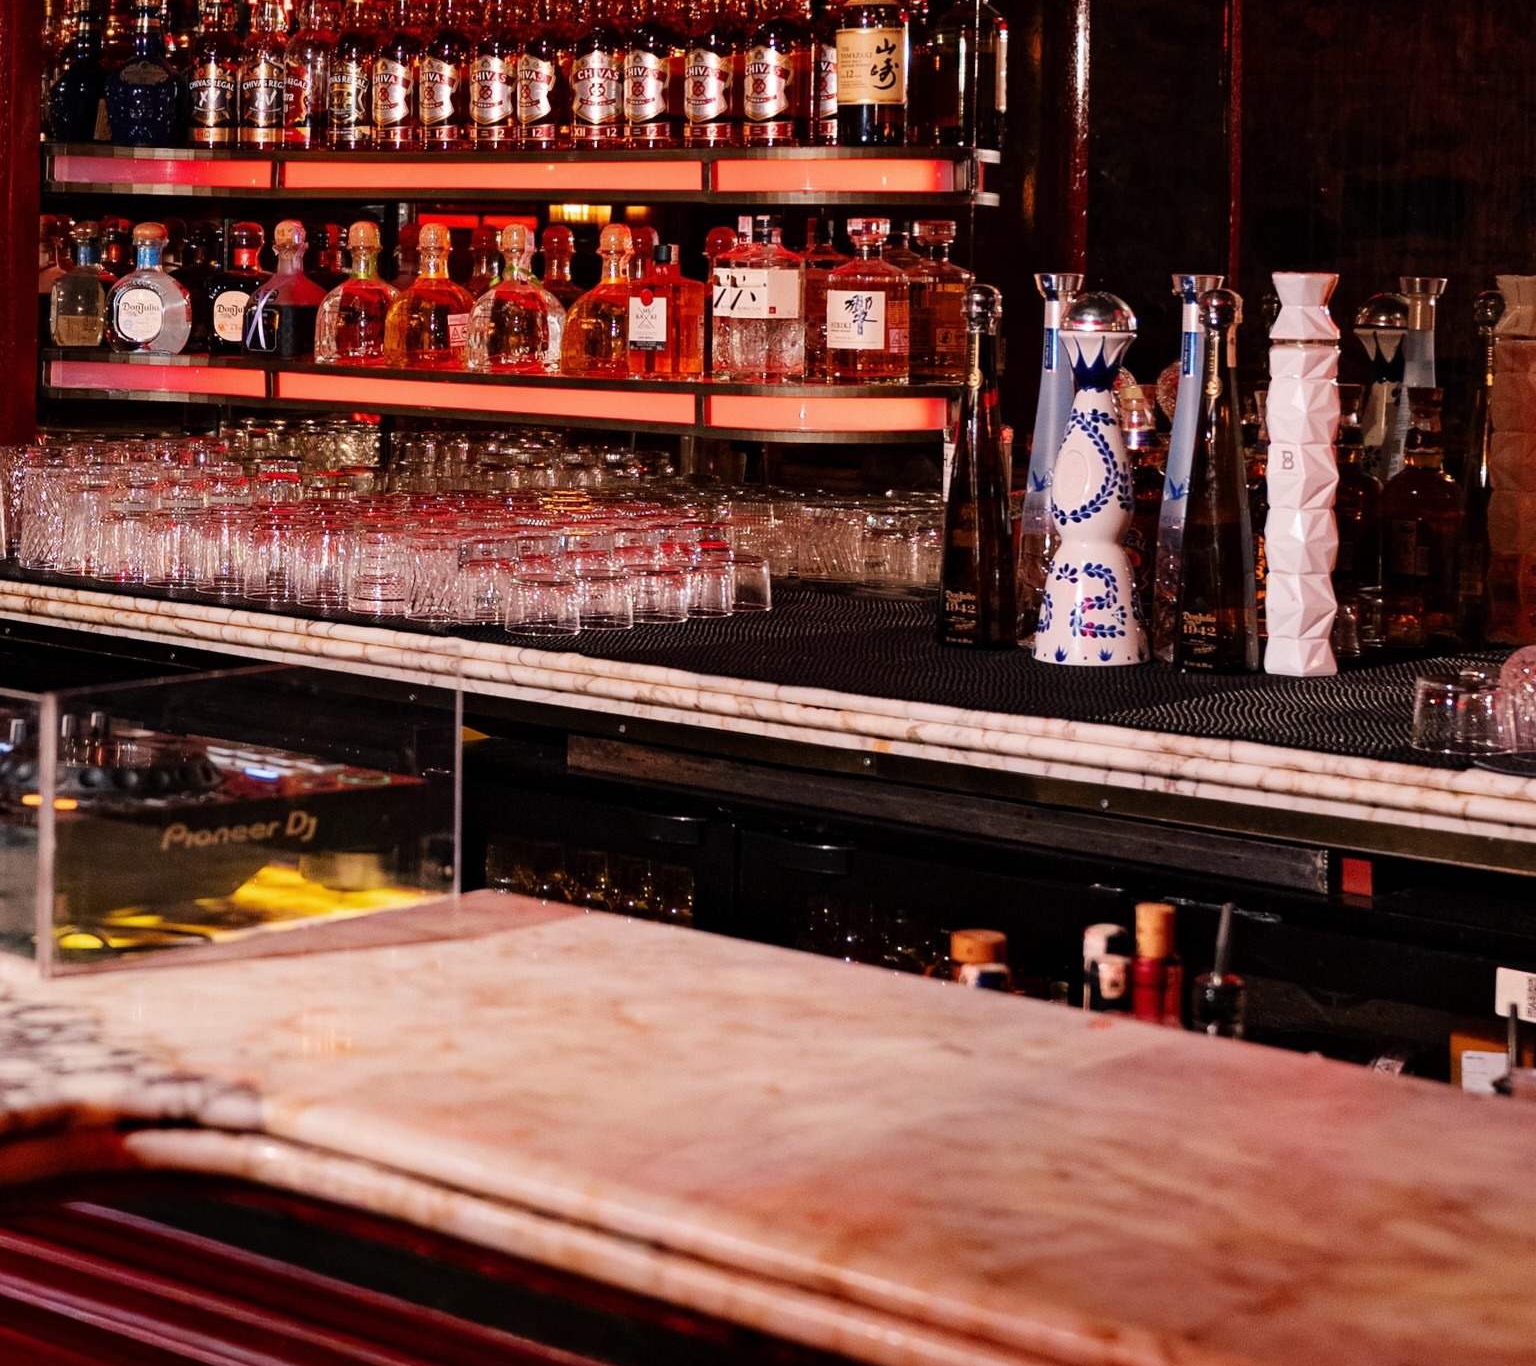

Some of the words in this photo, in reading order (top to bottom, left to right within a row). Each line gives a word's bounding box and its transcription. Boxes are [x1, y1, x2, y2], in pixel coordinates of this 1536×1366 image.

[845, 69, 854, 78] 12
[532, 127, 543, 137] 12
[606, 127, 617, 137] 12
[945, 602, 976, 614] 1942
[1182, 623, 1217, 636] 1942
[160, 821, 280, 850] Pioneer
